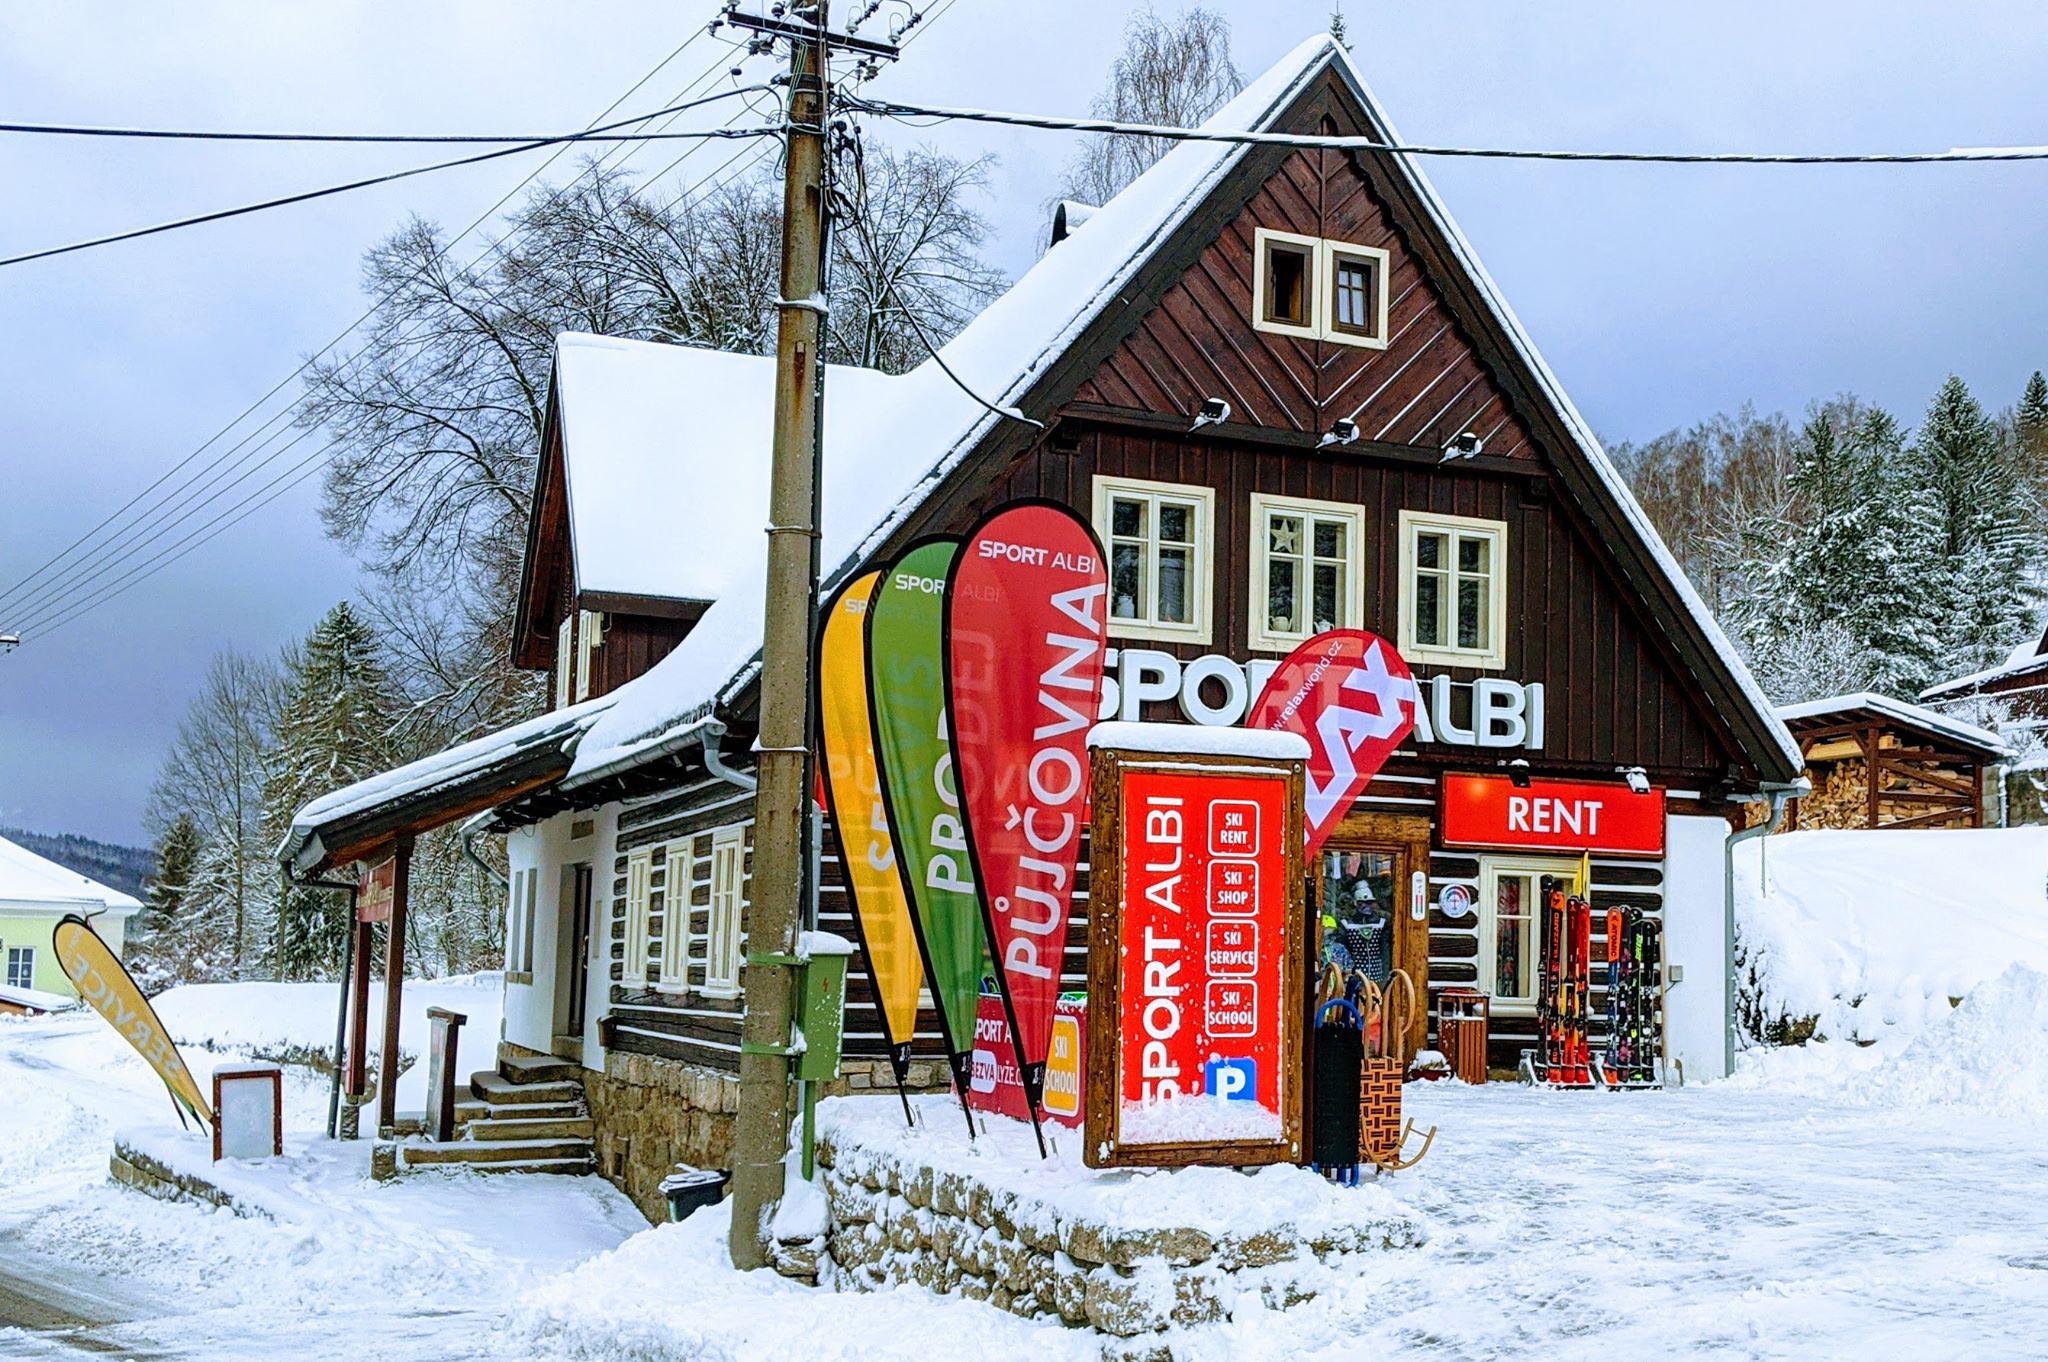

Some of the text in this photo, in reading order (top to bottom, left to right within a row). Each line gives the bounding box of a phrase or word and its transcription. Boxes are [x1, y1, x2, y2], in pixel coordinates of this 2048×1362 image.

[979, 540, 1097, 575] SPORT ALBI
[895, 574, 945, 594] SPOR
[995, 583, 1107, 979] PŮJČOVNA
[1225, 812, 1243, 828] SKI
[1508, 796, 1603, 837] RENT
[1220, 829, 1247, 846] RENT
[1224, 870, 1242, 886] SKI
[1217, 890, 1249, 906] SHOP
[1223, 930, 1242, 946] SKI
[1143, 797, 1184, 1110] SPORT ALBI
[1211, 949, 1255, 966] SERVICE
[1222, 990, 1240, 1006] SKI
[1208, 1010, 1253, 1026] SCHOOL
[974, 1018, 1003, 1043] PORT
[1055, 1036, 1069, 1058] SKI
[997, 1060, 1025, 1087] LYŽE.C
[1045, 1068, 1077, 1095] SCHOOL
